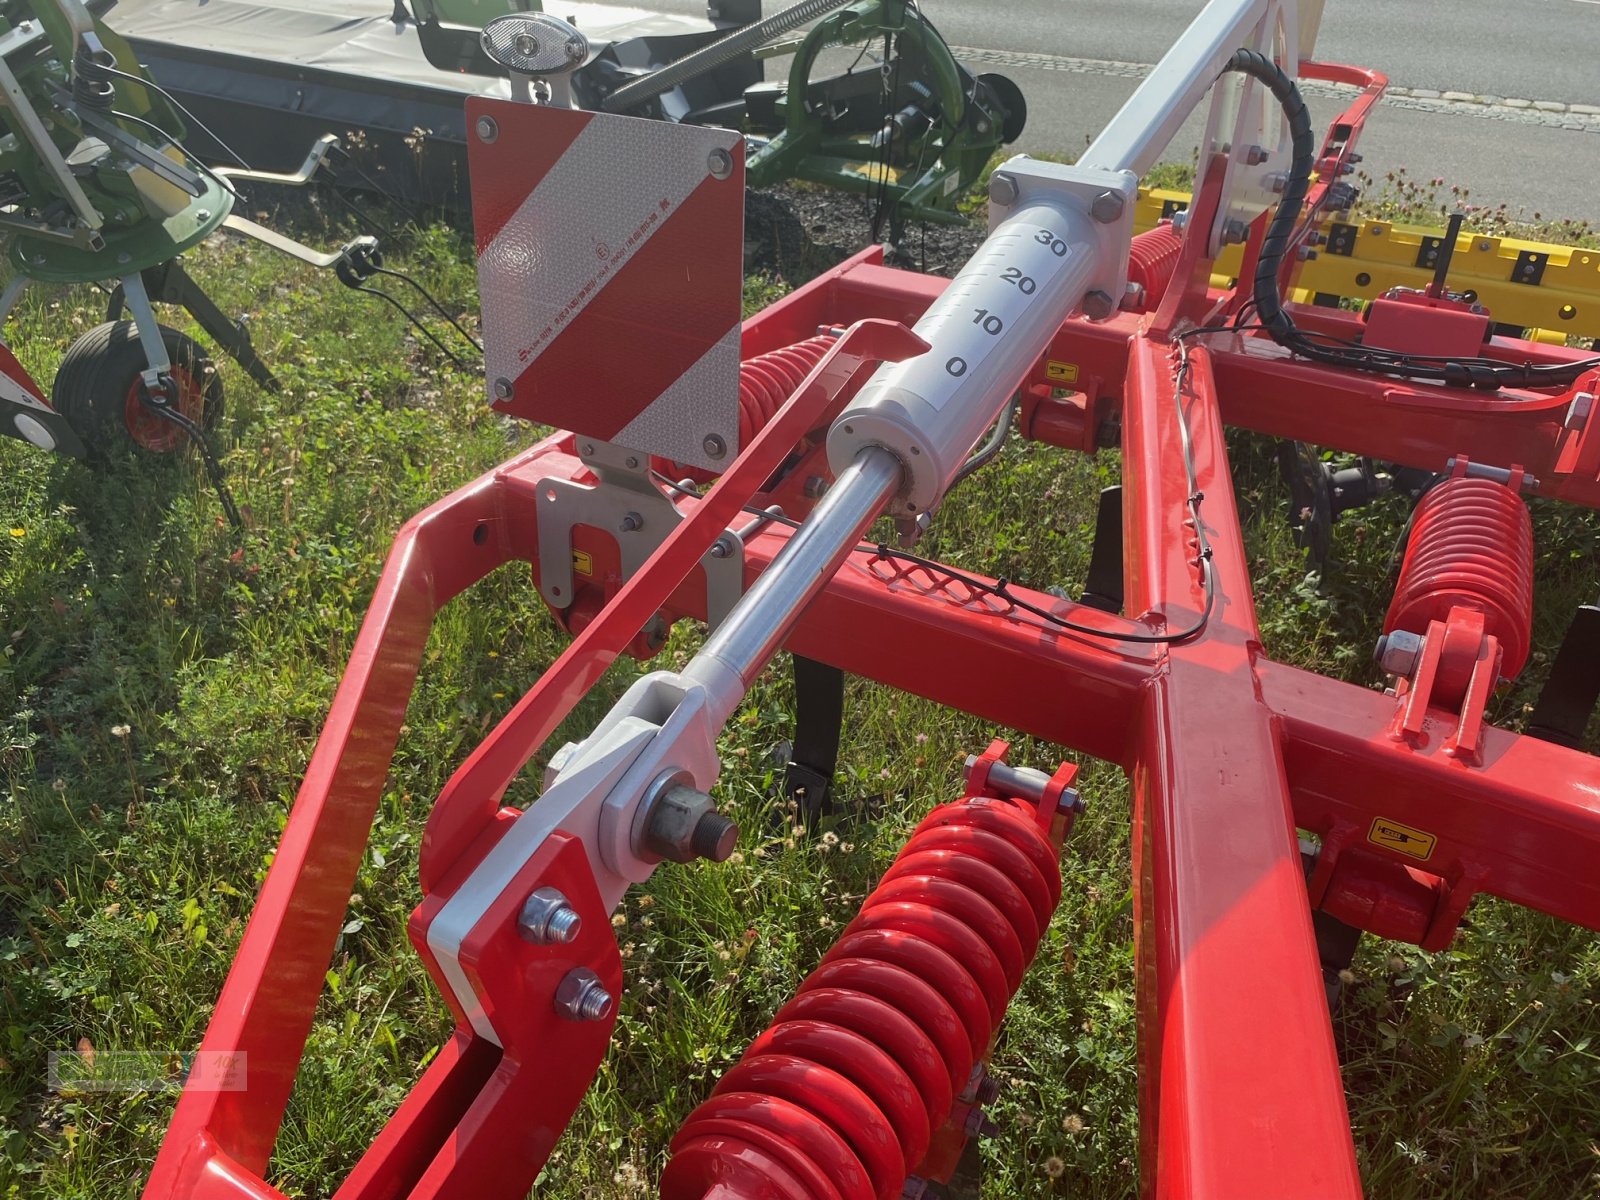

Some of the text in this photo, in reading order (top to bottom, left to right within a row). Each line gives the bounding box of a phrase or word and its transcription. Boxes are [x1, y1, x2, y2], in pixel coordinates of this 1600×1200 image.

[1034, 229, 1068, 257] 30
[999, 266, 1037, 296] 20
[972, 308, 1004, 336] 10
[945, 356, 968, 378] 0
